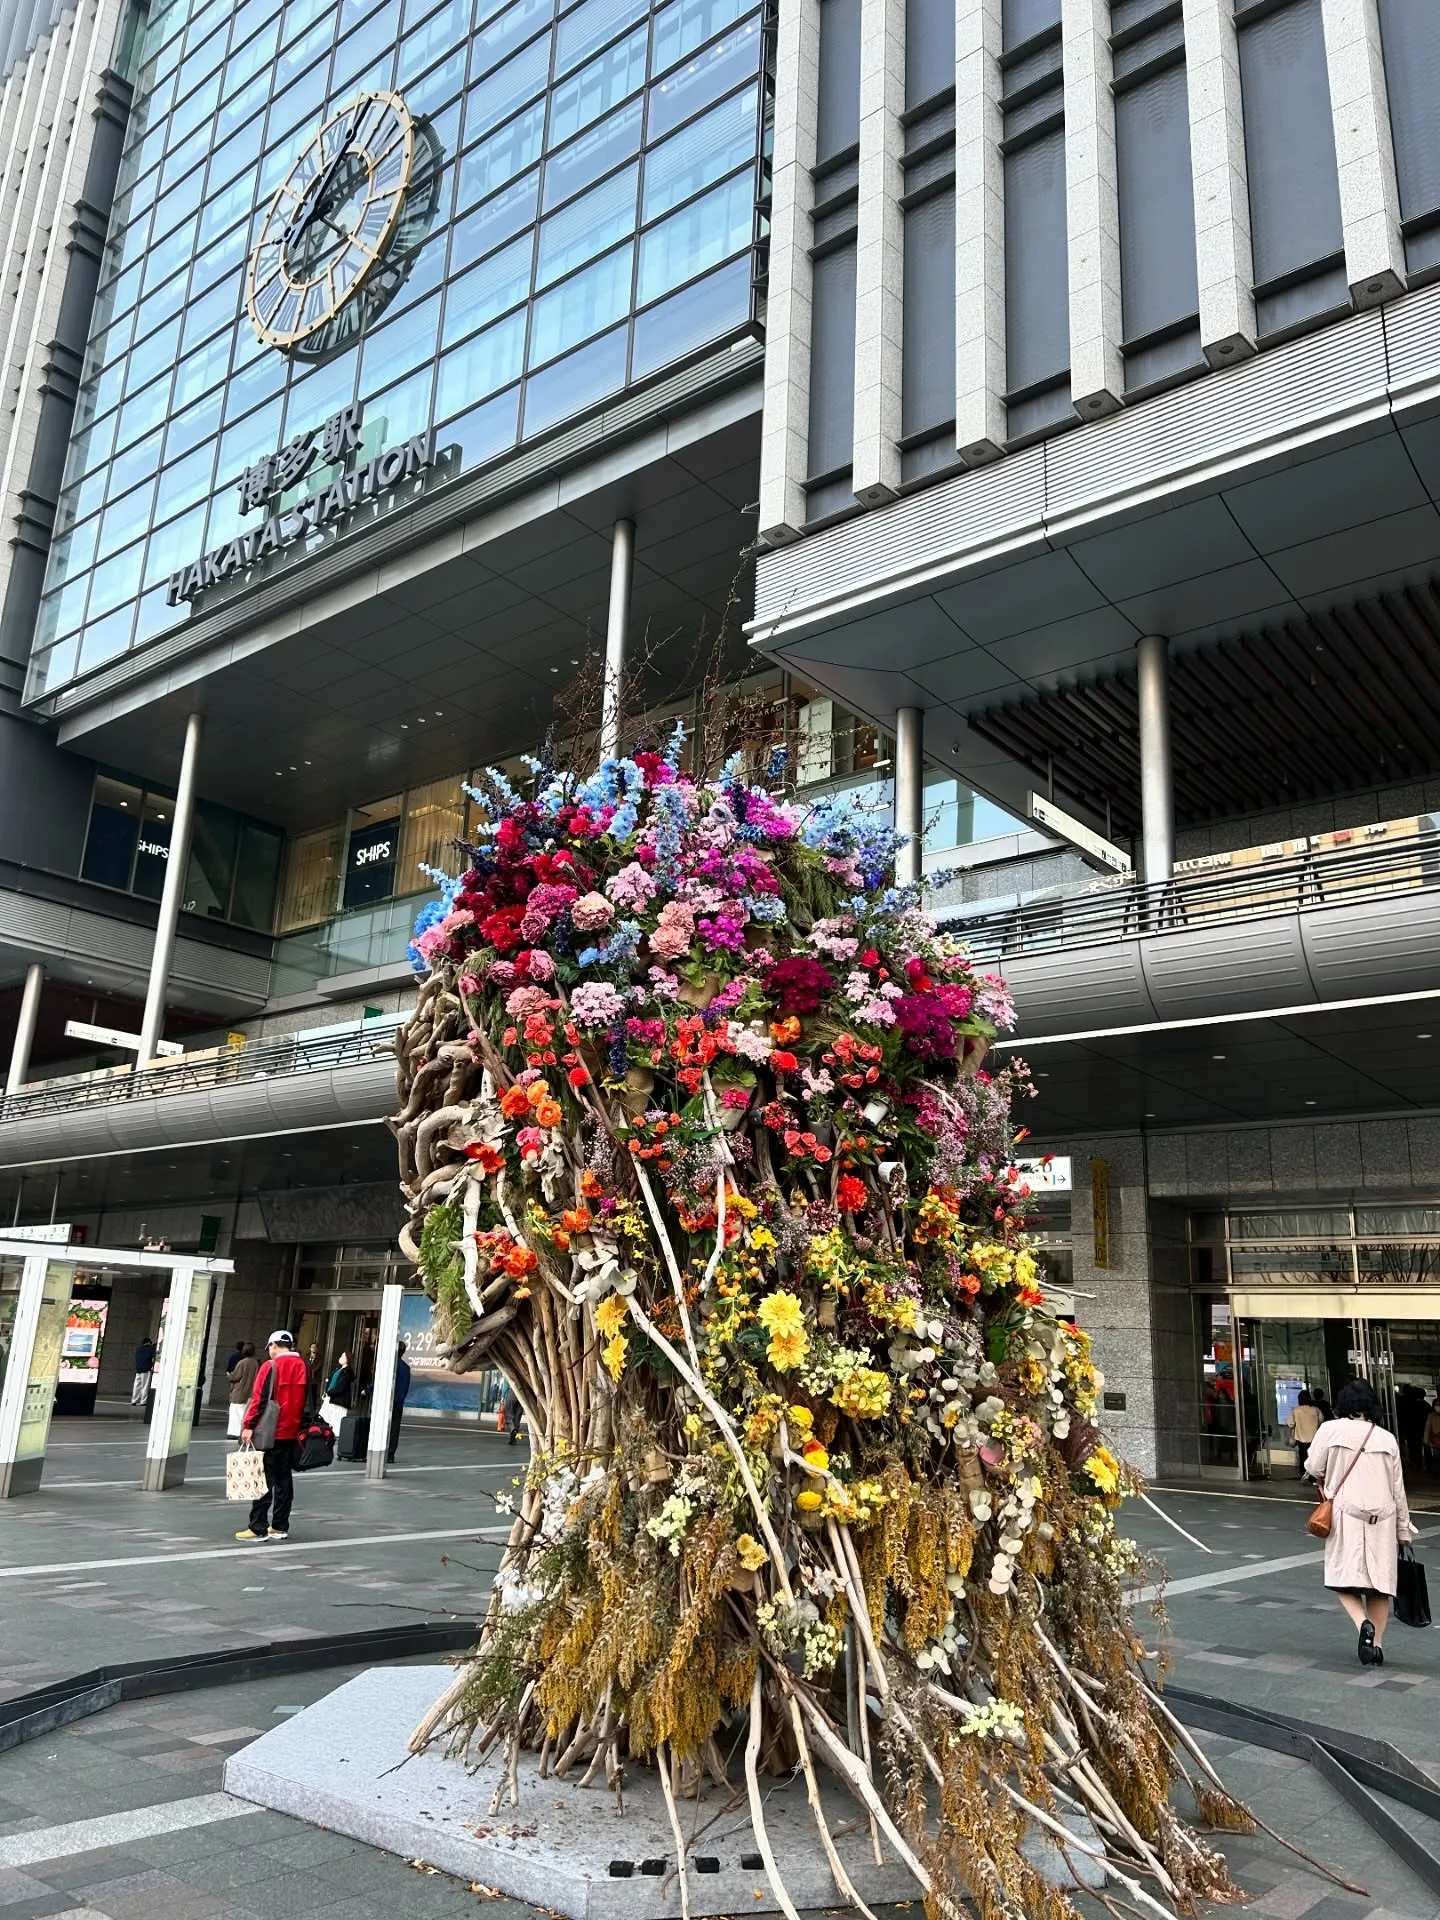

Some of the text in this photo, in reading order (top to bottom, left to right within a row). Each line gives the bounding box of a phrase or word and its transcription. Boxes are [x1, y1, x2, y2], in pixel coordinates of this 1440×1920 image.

[237, 399, 364, 516] 博多駅
[166, 427, 437, 606] HAKATA STATION
[356, 841, 391, 866] SHIPS
